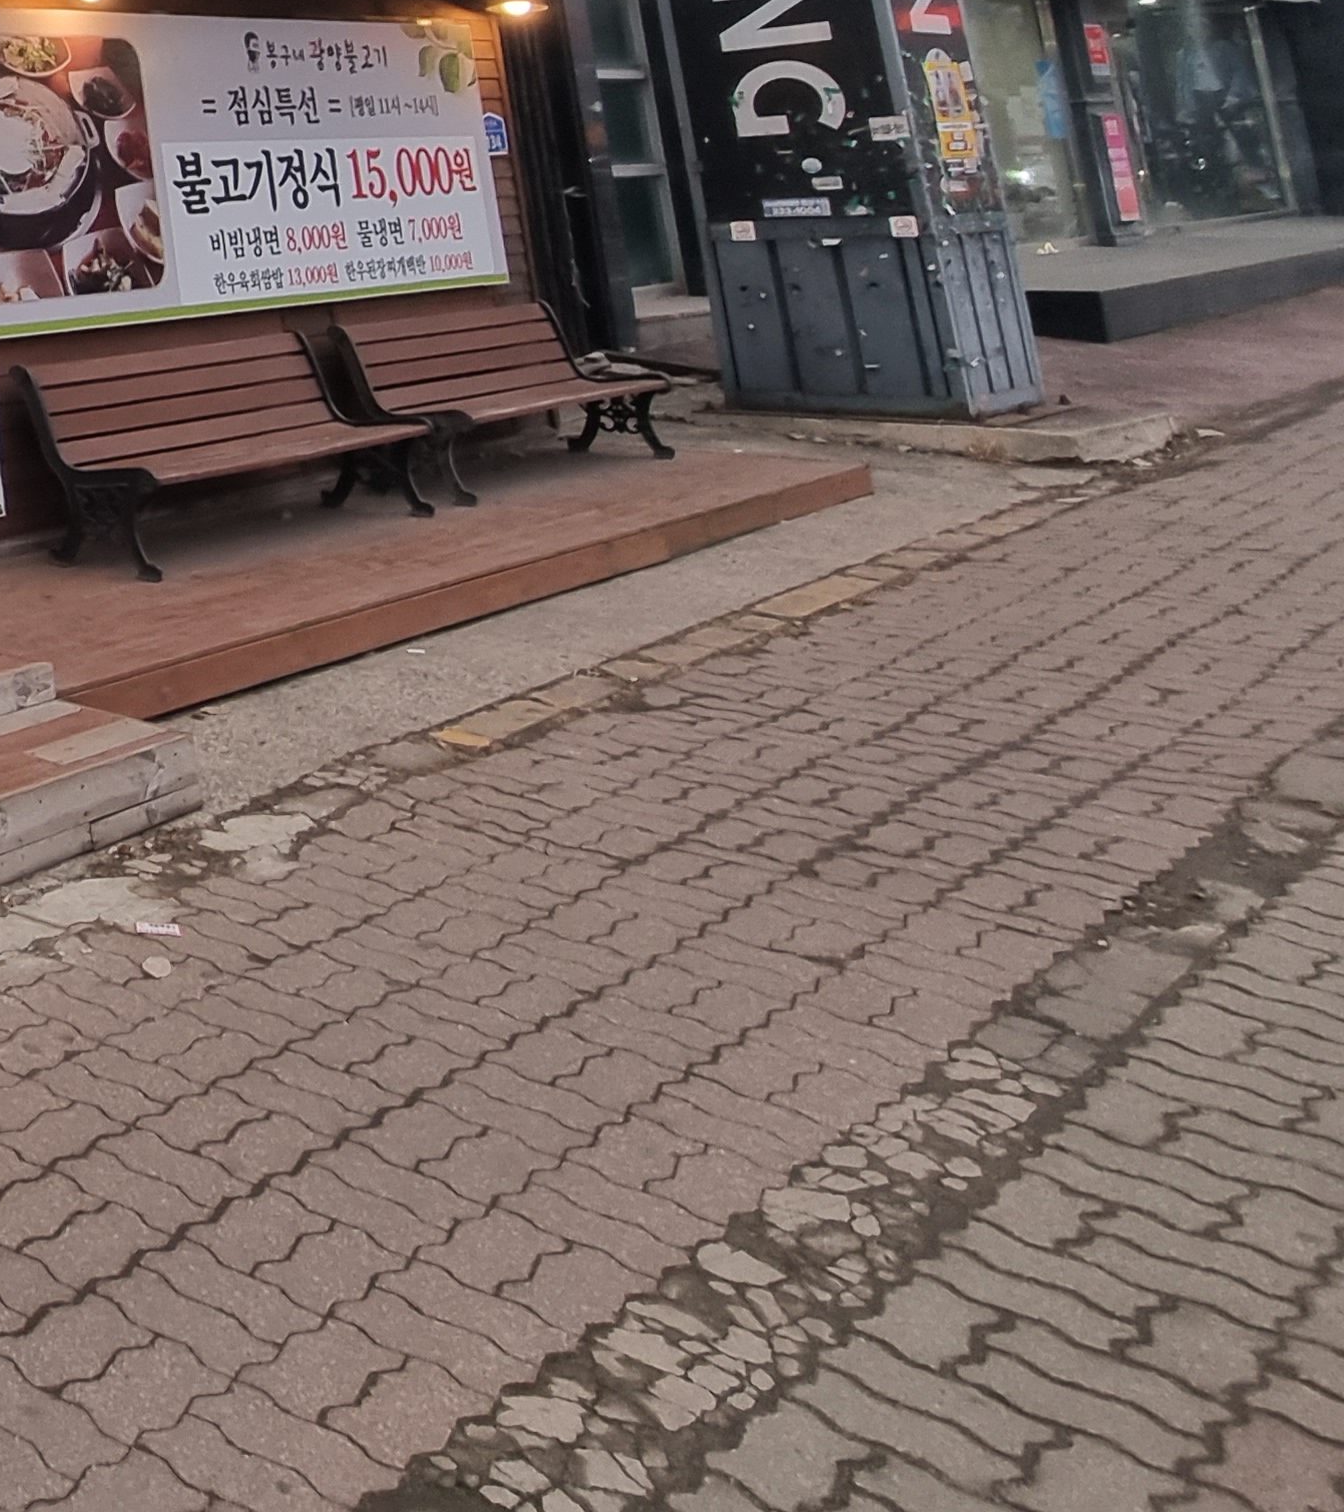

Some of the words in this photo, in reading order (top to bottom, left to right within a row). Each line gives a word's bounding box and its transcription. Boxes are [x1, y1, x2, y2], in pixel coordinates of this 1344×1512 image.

[265, 39, 305, 70] 봉구네
[308, 36, 388, 75] 광양불고기
[227, 85, 321, 126] 점심특선
[172, 147, 342, 215] 불고기정식
[346, 145, 478, 209] 15,000원
[209, 225, 283, 260] 비빔냉면
[285, 221, 349, 256] 8,000원
[356, 217, 405, 249] 물냉면
[288, 261, 339, 287] 13,000원
